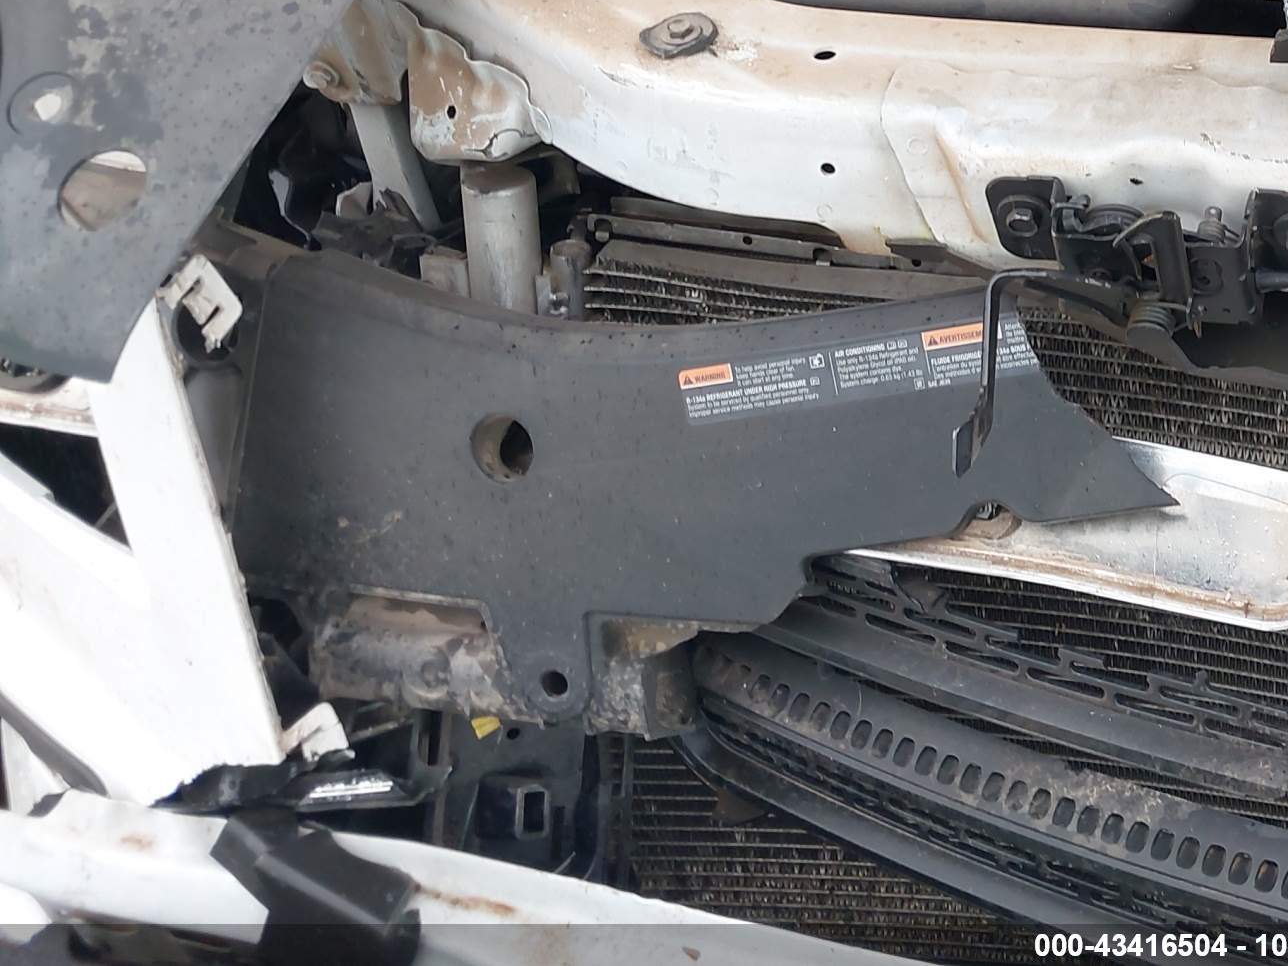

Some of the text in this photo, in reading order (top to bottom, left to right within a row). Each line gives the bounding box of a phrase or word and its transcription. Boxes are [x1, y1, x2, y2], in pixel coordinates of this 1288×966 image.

[940, 330, 982, 343] AVERTISSEM
[835, 343, 885, 358] AIR CONDITIONING
[931, 355, 950, 366] FLUIDE
[695, 372, 726, 382] WARNING
[706, 388, 743, 400] REFRIGERANT
[744, 386, 762, 395] UNDER
[764, 384, 777, 392] HIGH
[778, 379, 806, 390] PRESSURE
